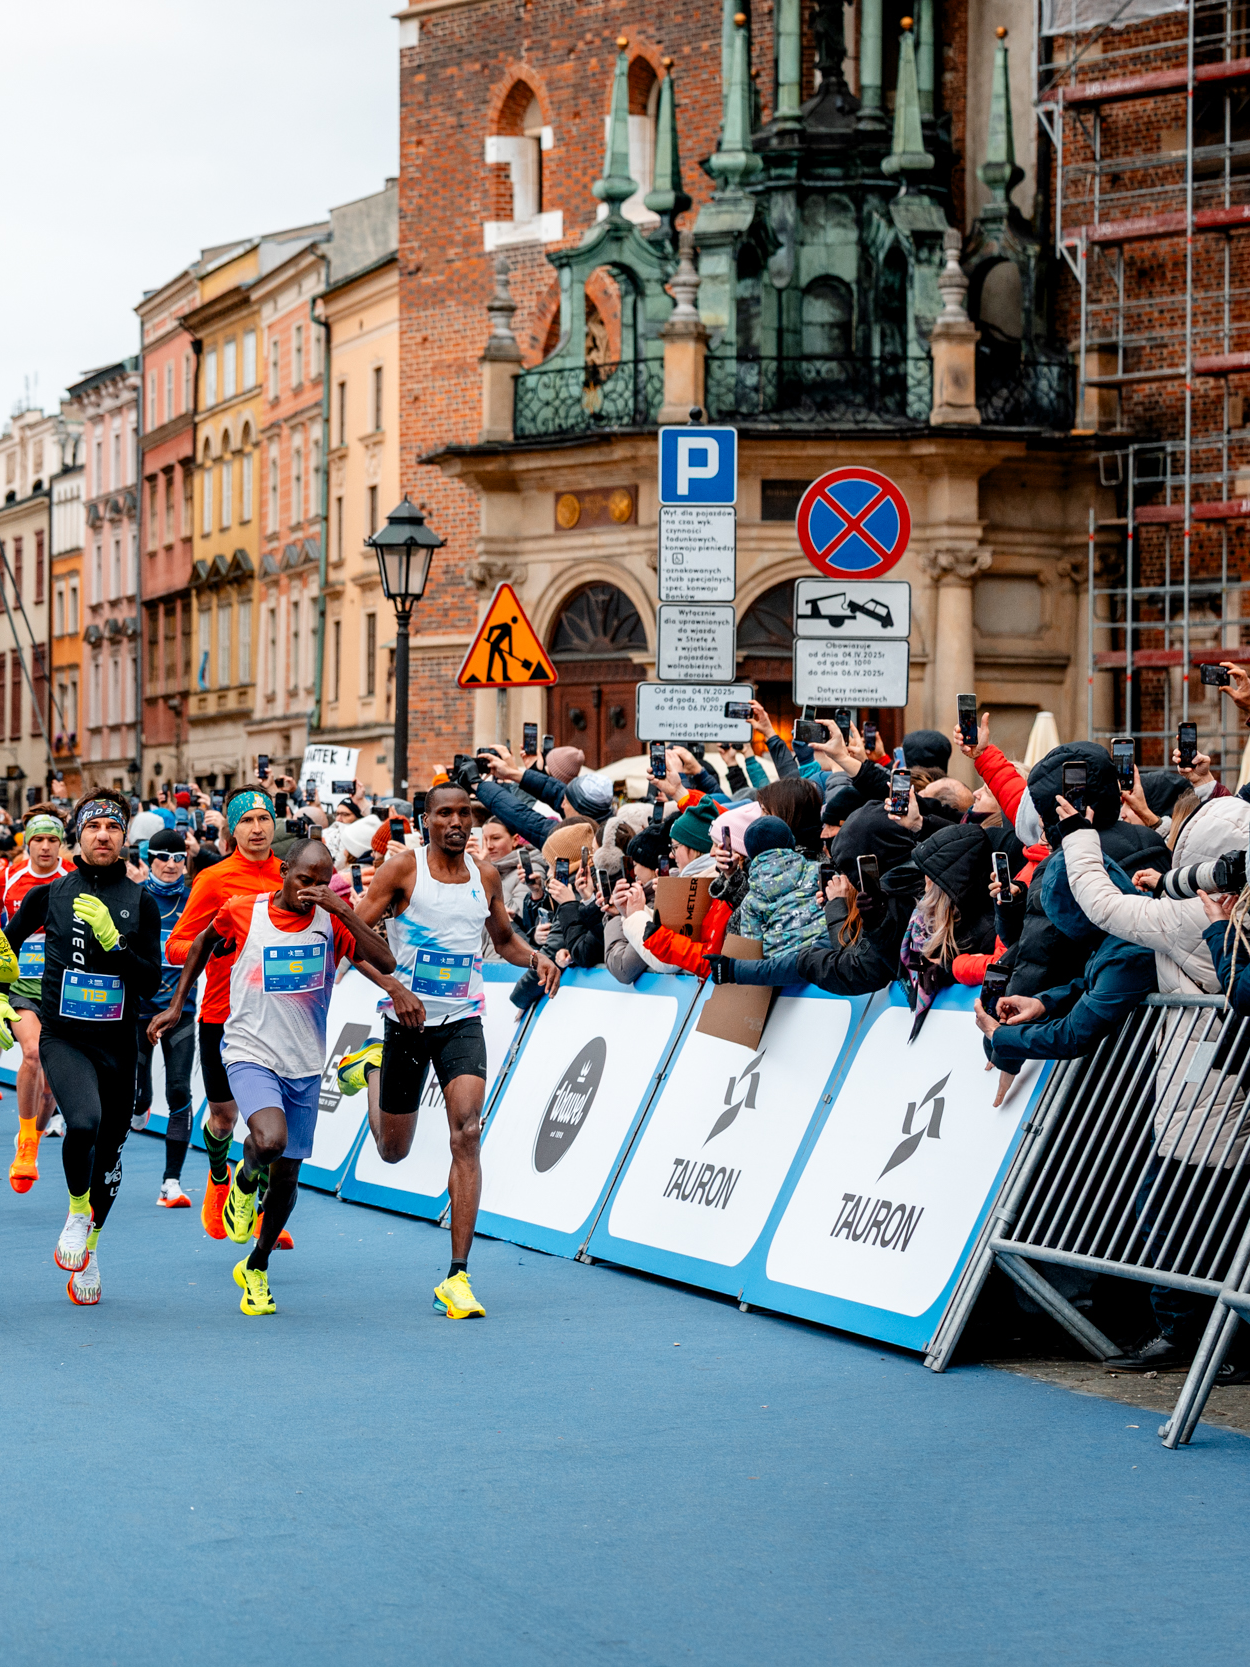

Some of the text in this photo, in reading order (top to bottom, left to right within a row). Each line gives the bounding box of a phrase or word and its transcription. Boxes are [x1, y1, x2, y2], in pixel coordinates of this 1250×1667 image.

[677, 436, 719, 495] P
[696, 509, 733, 518] pojazdów
[687, 585, 718, 593] konwoju
[679, 618, 730, 626] uprawnionych
[669, 687, 686, 695] dnia
[817, 687, 846, 695] Dotyczy
[659, 722, 739, 730] miejsca parkingowe
[686, 877, 698, 920] METLER
[26, 953, 45, 963] 74
[289, 961, 303, 973] 6
[439, 968, 451, 979] 5
[82, 989, 107, 1002] 113
[663, 1157, 742, 1210] TAURON
[830, 1192, 925, 1252] TAURON
